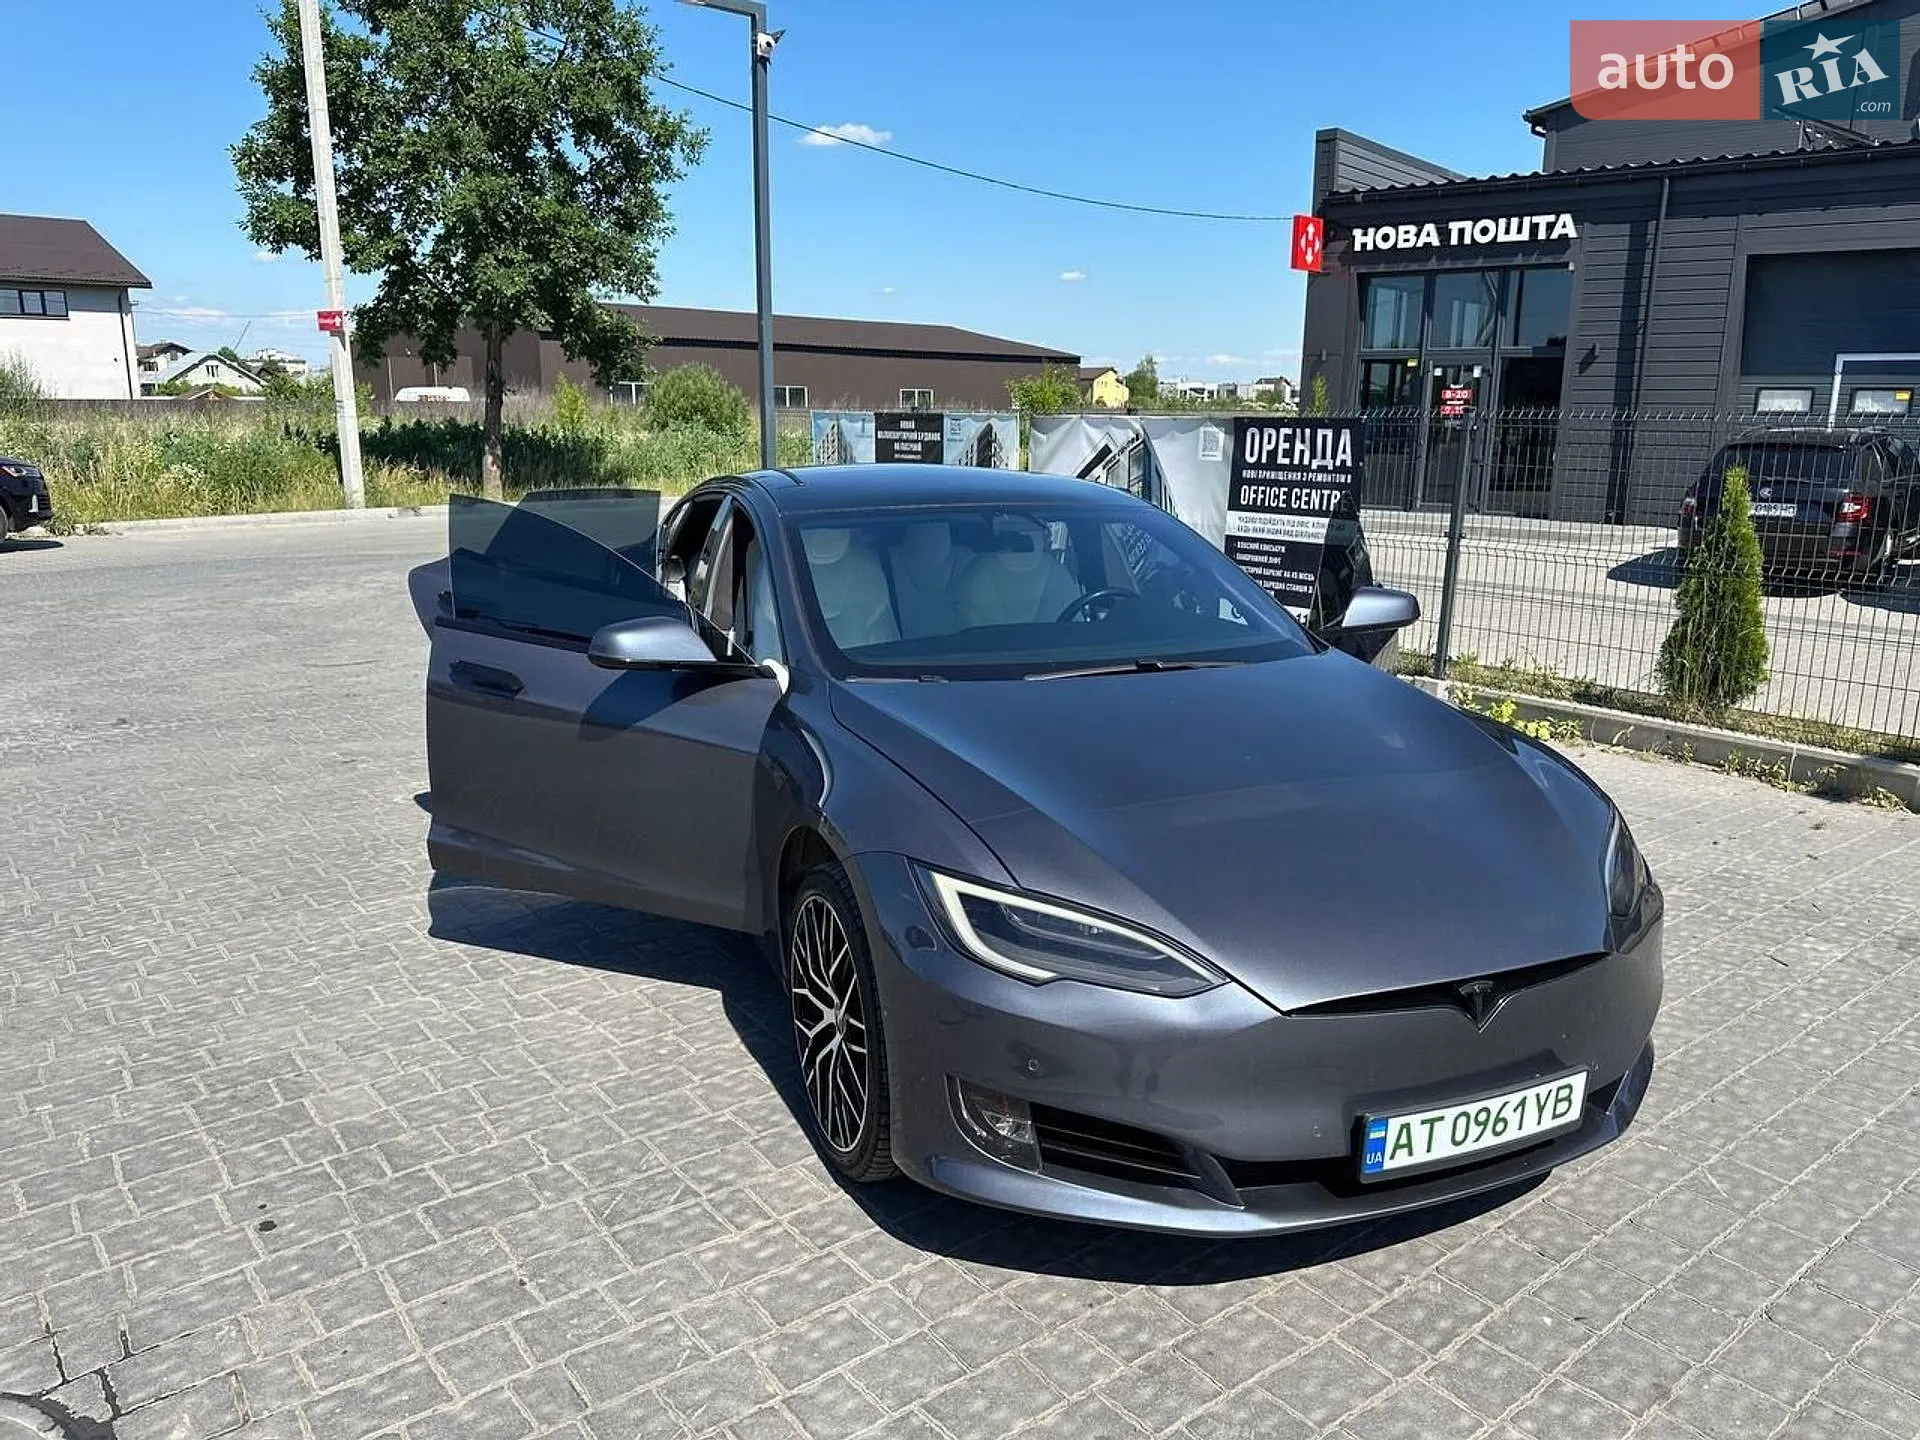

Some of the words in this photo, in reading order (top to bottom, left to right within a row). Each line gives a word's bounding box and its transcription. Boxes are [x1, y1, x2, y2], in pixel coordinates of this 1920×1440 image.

[1351, 223, 1440, 252] НОВА
[1448, 213, 1578, 246] ПОШТА
[1245, 427, 1352, 470] ОРЕНДА
[1240, 485, 1288, 508] OFFICE
[1366, 1152, 1383, 1164] UA
